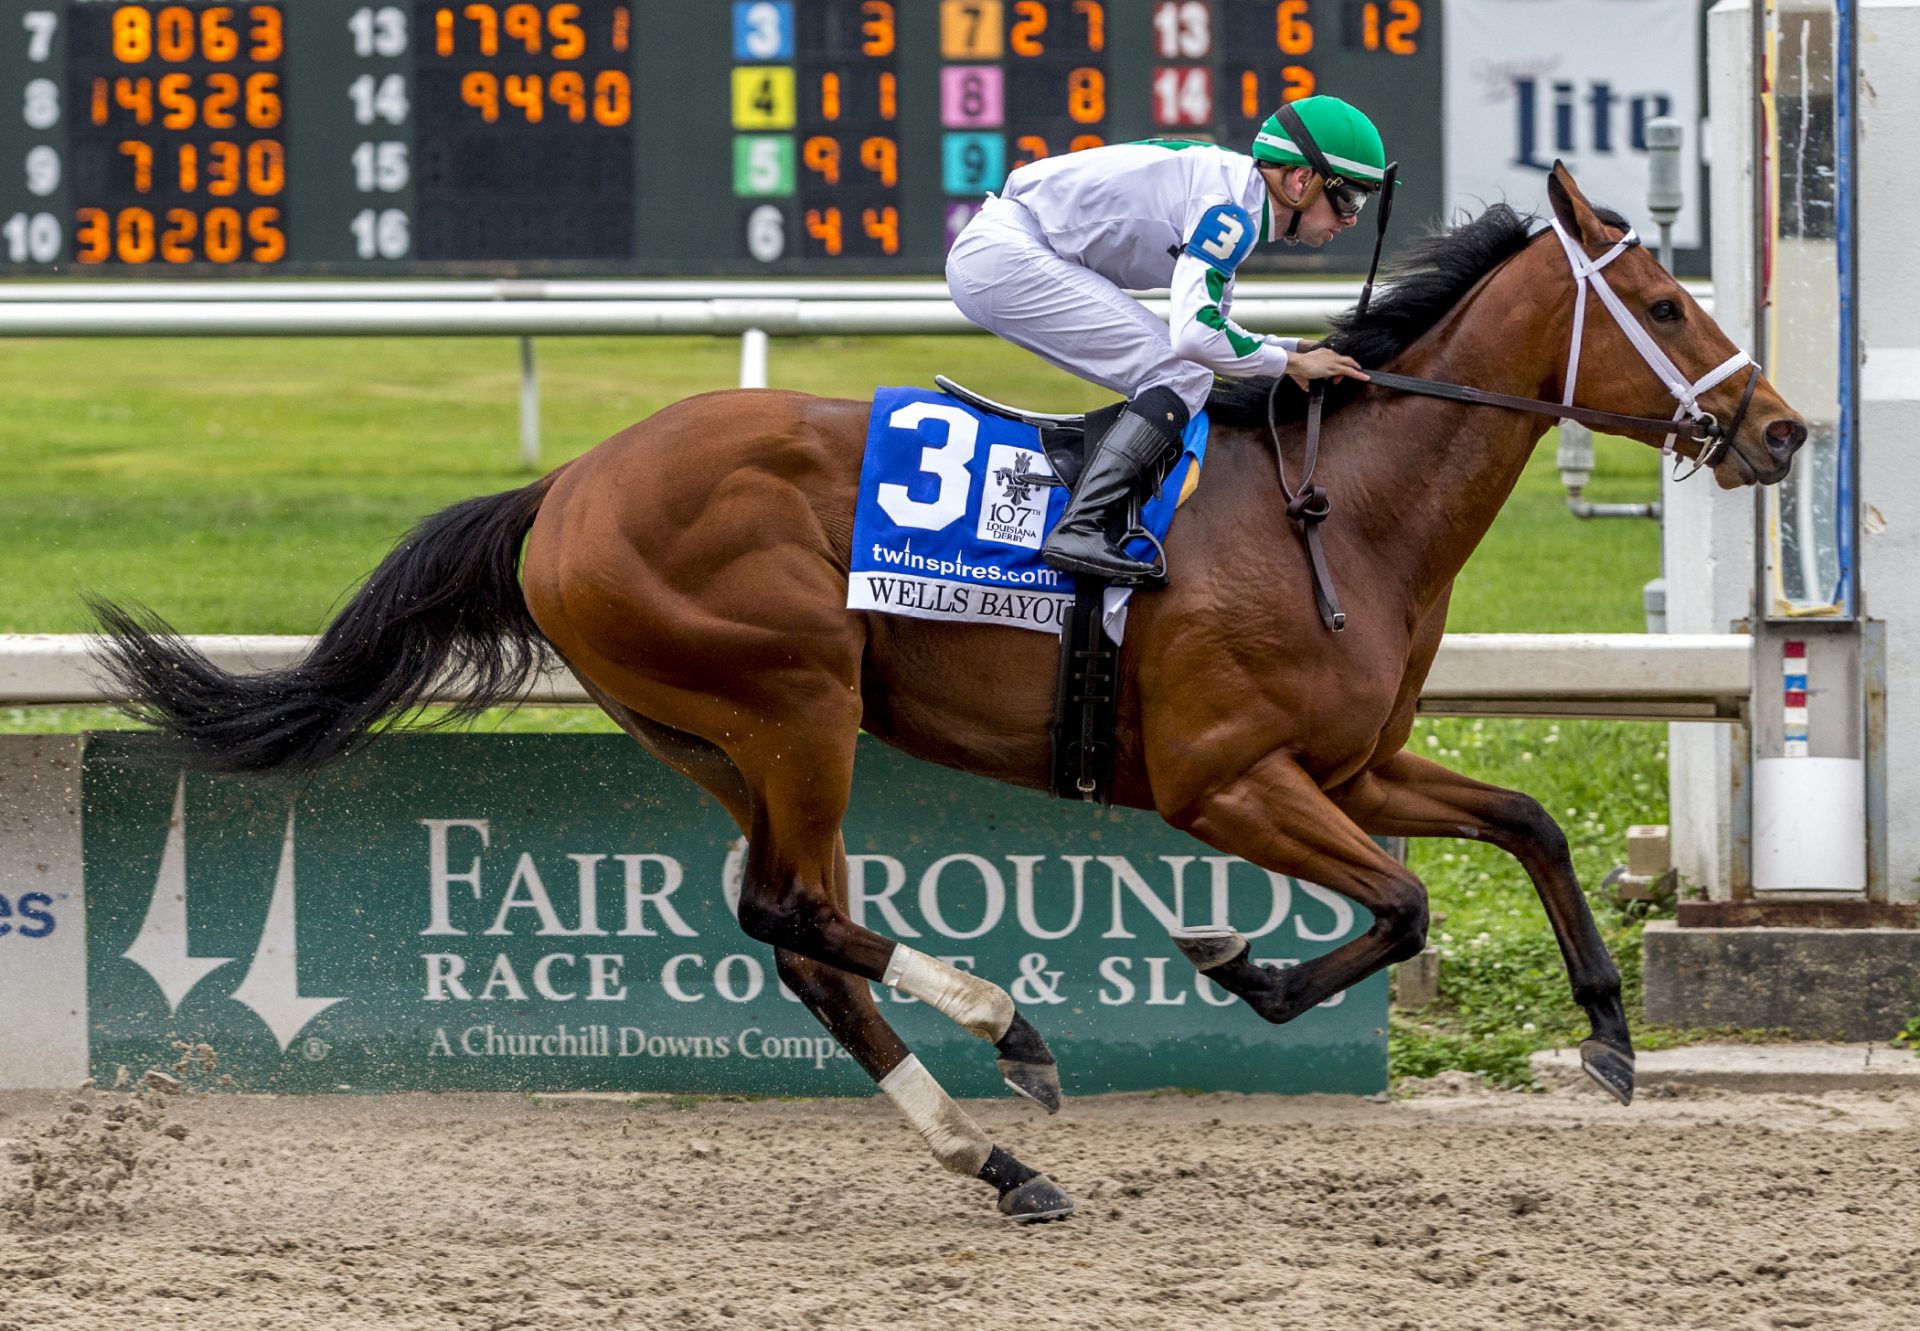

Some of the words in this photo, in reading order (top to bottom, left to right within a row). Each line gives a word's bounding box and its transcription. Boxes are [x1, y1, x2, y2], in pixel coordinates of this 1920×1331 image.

[23, 10, 58, 63] 7
[111, 5, 284, 64] 8063
[348, 6, 409, 58] 13
[747, 2, 781, 59] 3
[862, 1, 896, 57] 3
[962, 6, 982, 49] 7
[1153, 1, 1211, 58] 13
[1275, 0, 1315, 56] 6
[1361, 0, 1422, 56] 12
[23, 78, 60, 129] 8
[90, 71, 283, 131] 14526
[348, 73, 410, 126] 14
[460, 69, 632, 127] 9490
[753, 78, 774, 117] 4
[960, 74, 985, 118] 8
[1067, 66, 1106, 124] 8
[1153, 66, 1211, 125] 14
[1509, 74, 1672, 173] Lite
[25, 145, 61, 196] 9
[119, 138, 285, 197] 7130
[351, 142, 409, 192] 15
[749, 138, 781, 193] 5
[963, 143, 986, 183] 9
[3, 212, 62, 263] 10
[76, 206, 286, 264] 30205
[351, 208, 409, 259] 16
[747, 204, 785, 262] 6
[1201, 212, 1245, 260] 3
[877, 401, 979, 531] 3
[986, 521, 1037, 538] LOUISIANA
[993, 531, 1025, 542] DERBY
[872, 538, 1058, 586] twinspires.com
[867, 577, 970, 614] WELLS
[977, 591, 1076, 627] BAYOU
[420, 818, 699, 937] FAIR
[722, 834, 1354, 942] ROUNDS
[421, 953, 628, 1001] RACE
[1010, 953, 1068, 1005] &
[428, 1028, 455, 1057] A
[460, 1025, 608, 1057] Churchill
[617, 1027, 730, 1058] Downs
[737, 1027, 854, 1070] Compa
